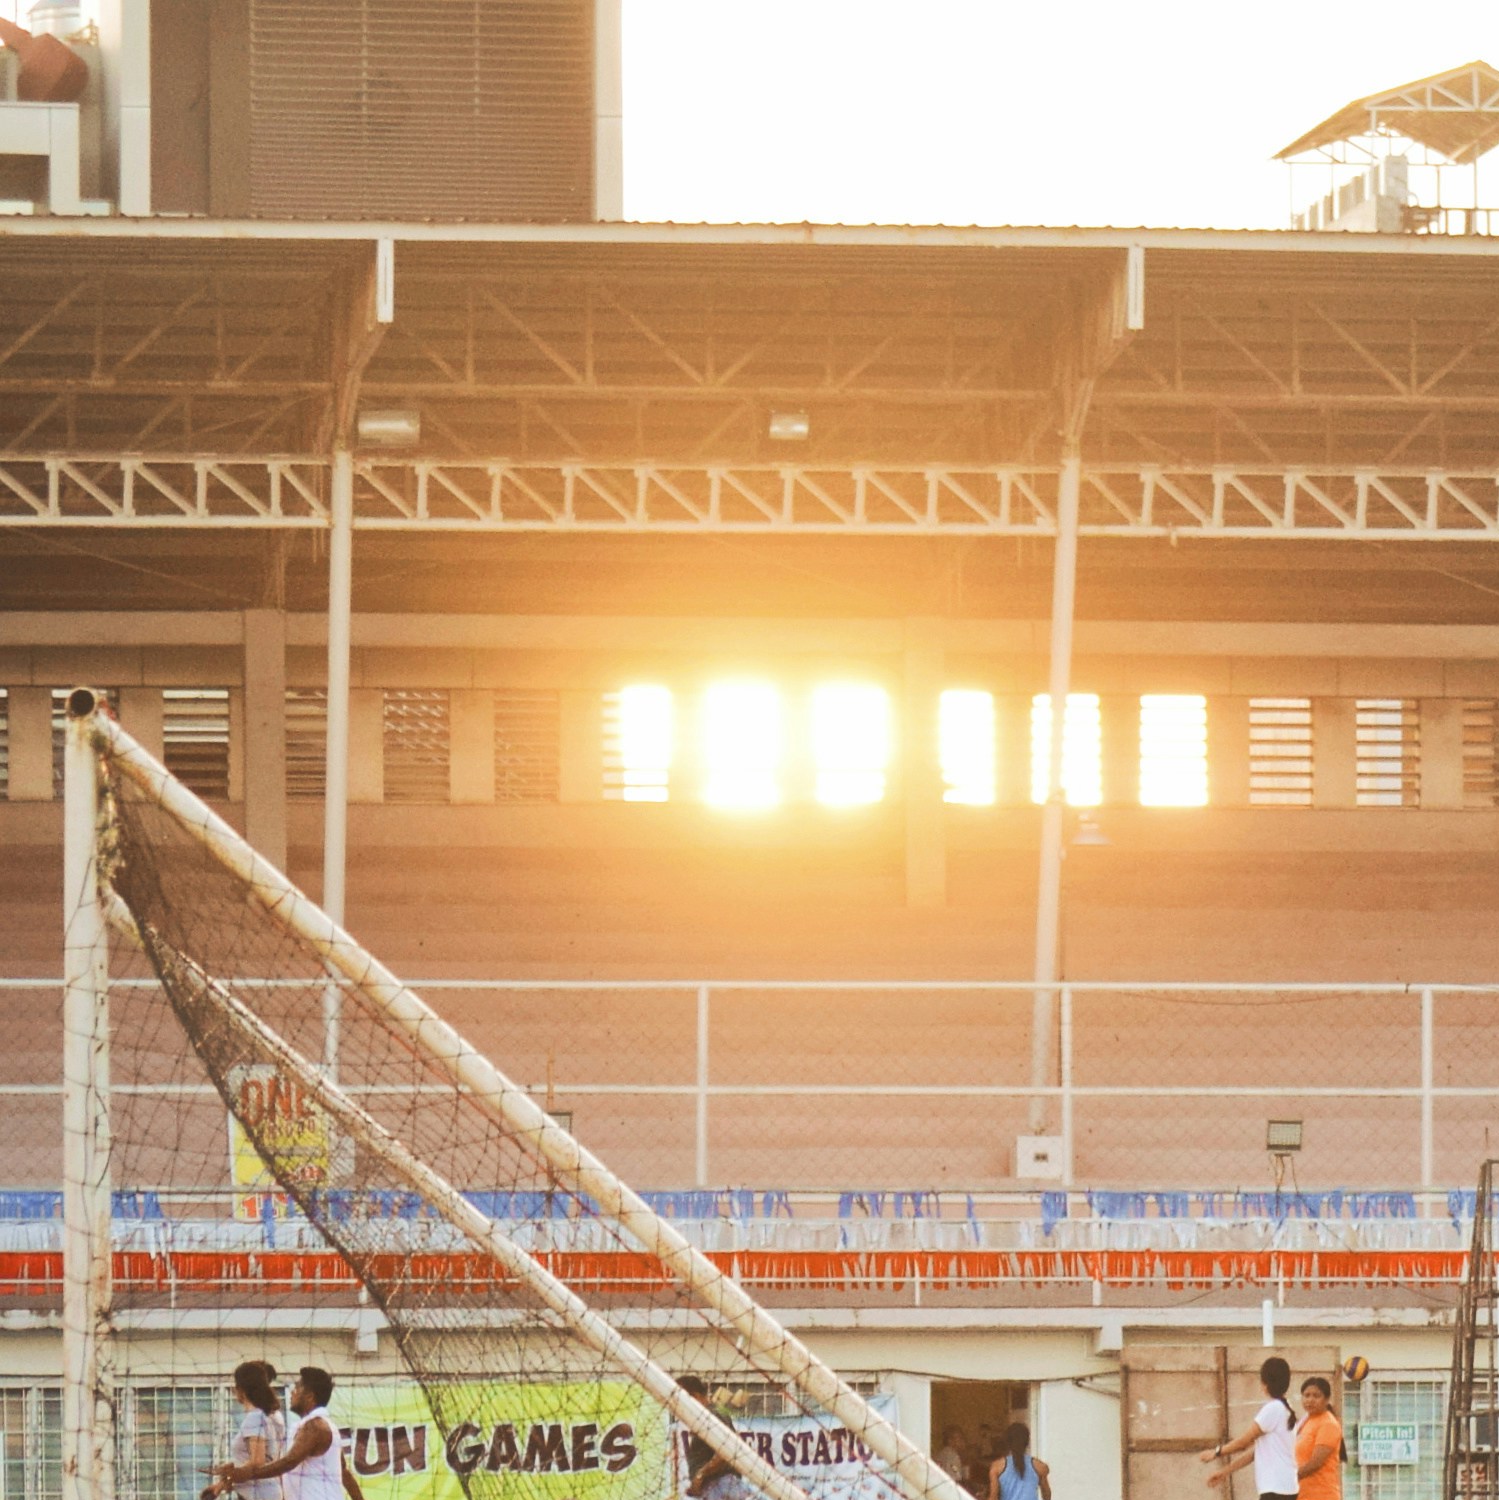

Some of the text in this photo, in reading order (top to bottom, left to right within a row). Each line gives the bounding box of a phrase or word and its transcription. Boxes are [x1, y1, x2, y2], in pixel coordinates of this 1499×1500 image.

[338, 1423, 637, 1475] FUN GAMES
[781, 1427, 877, 1467] STATIO
[1361, 1427, 1413, 1440] Pitch In!
